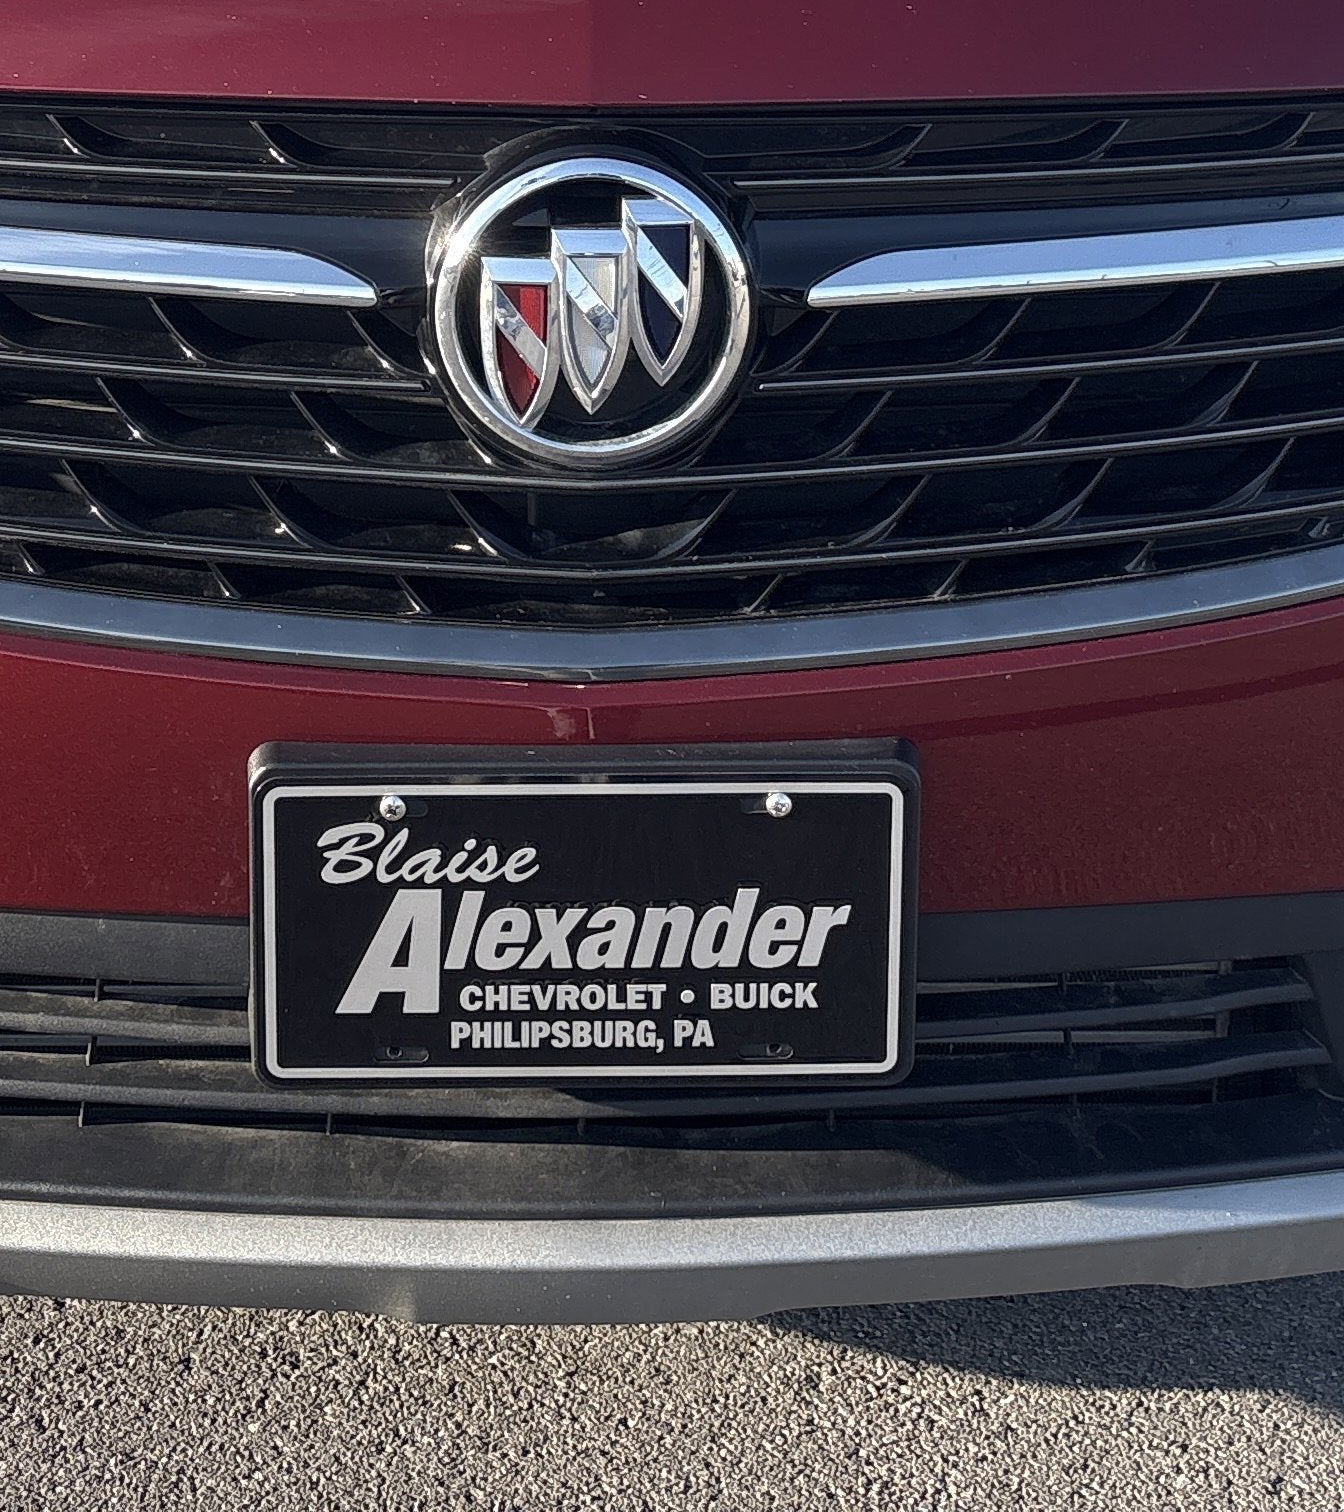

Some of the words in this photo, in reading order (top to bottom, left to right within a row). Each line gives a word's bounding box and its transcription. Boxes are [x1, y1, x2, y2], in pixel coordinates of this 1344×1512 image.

[317, 823, 539, 884] Blaise
[335, 889, 851, 1014] Alexander
[459, 985, 666, 1011] CHEVROLET
[710, 983, 817, 1010] BUICK
[450, 1021, 664, 1053] PHILIPSBURG,
[673, 1020, 714, 1048] PA
